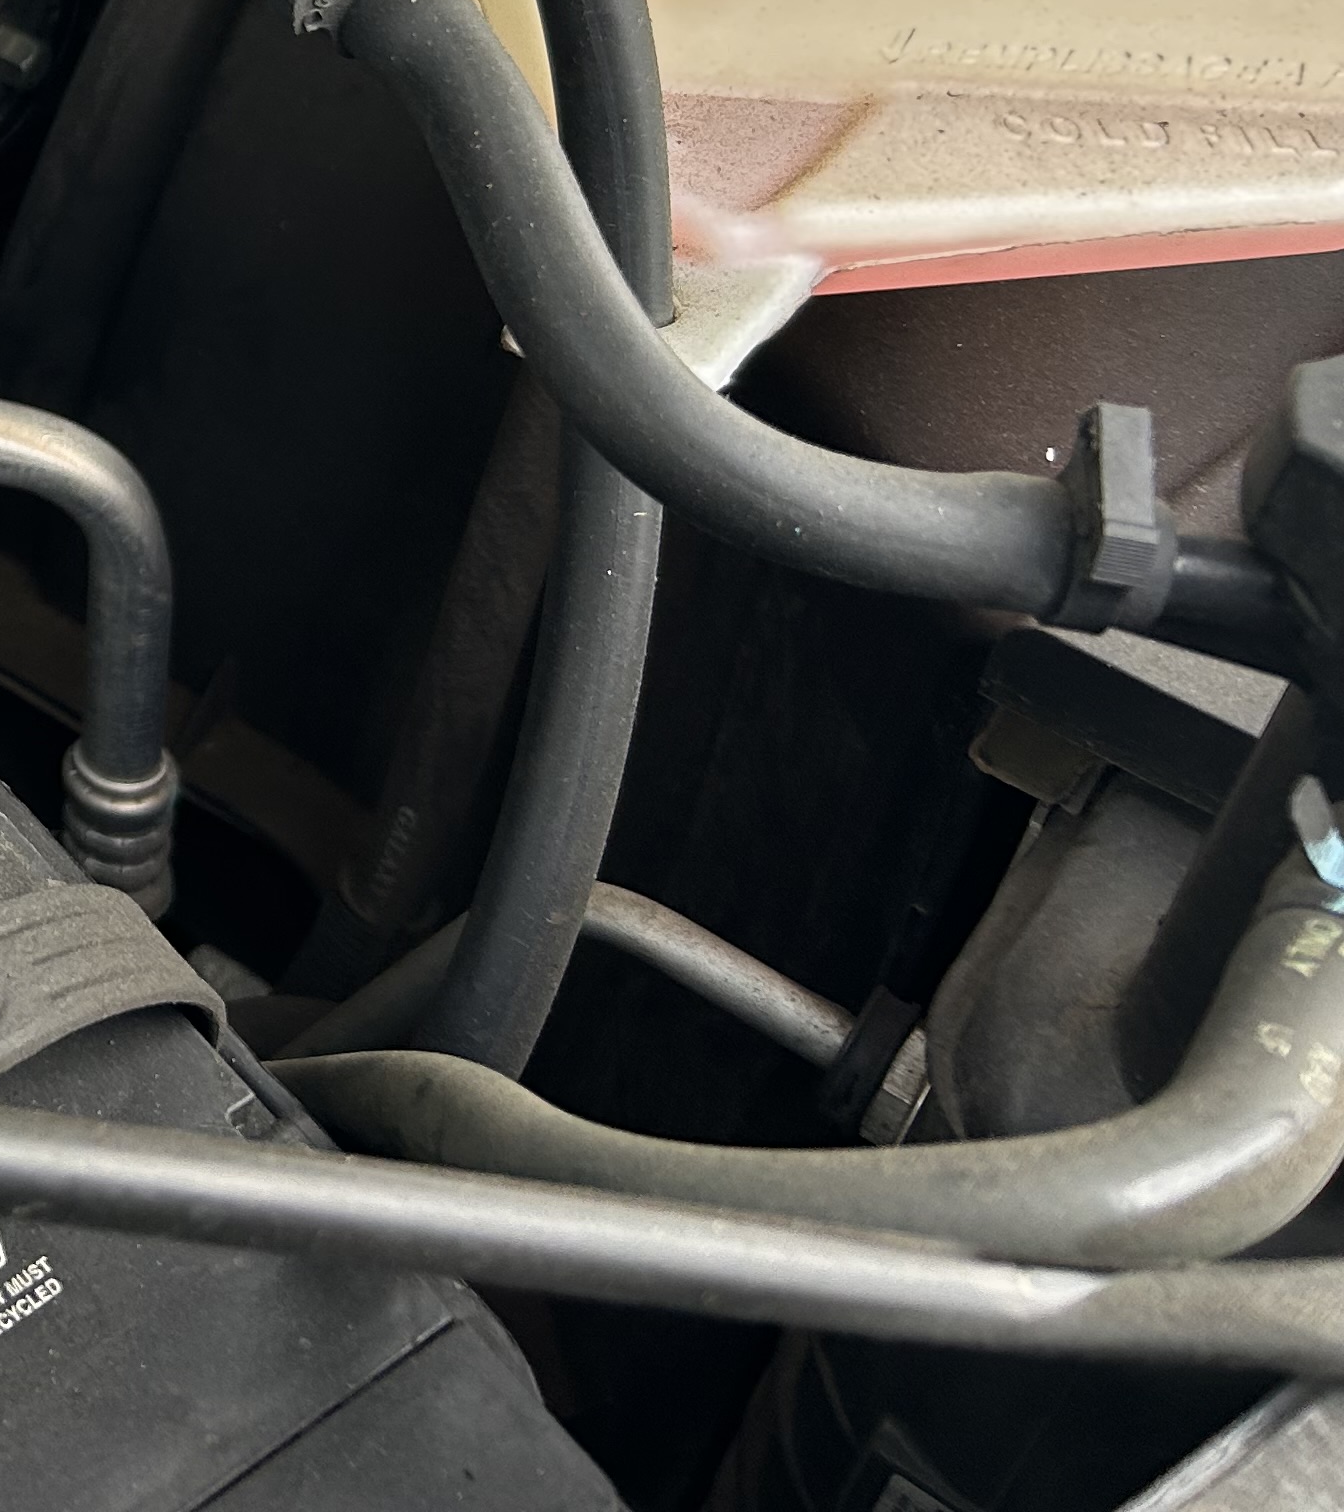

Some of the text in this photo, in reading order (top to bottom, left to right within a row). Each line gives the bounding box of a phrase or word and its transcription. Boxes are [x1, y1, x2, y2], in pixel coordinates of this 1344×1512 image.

[998, 113, 1340, 159] COLD FILL
[4, 1255, 53, 1297] MUST
